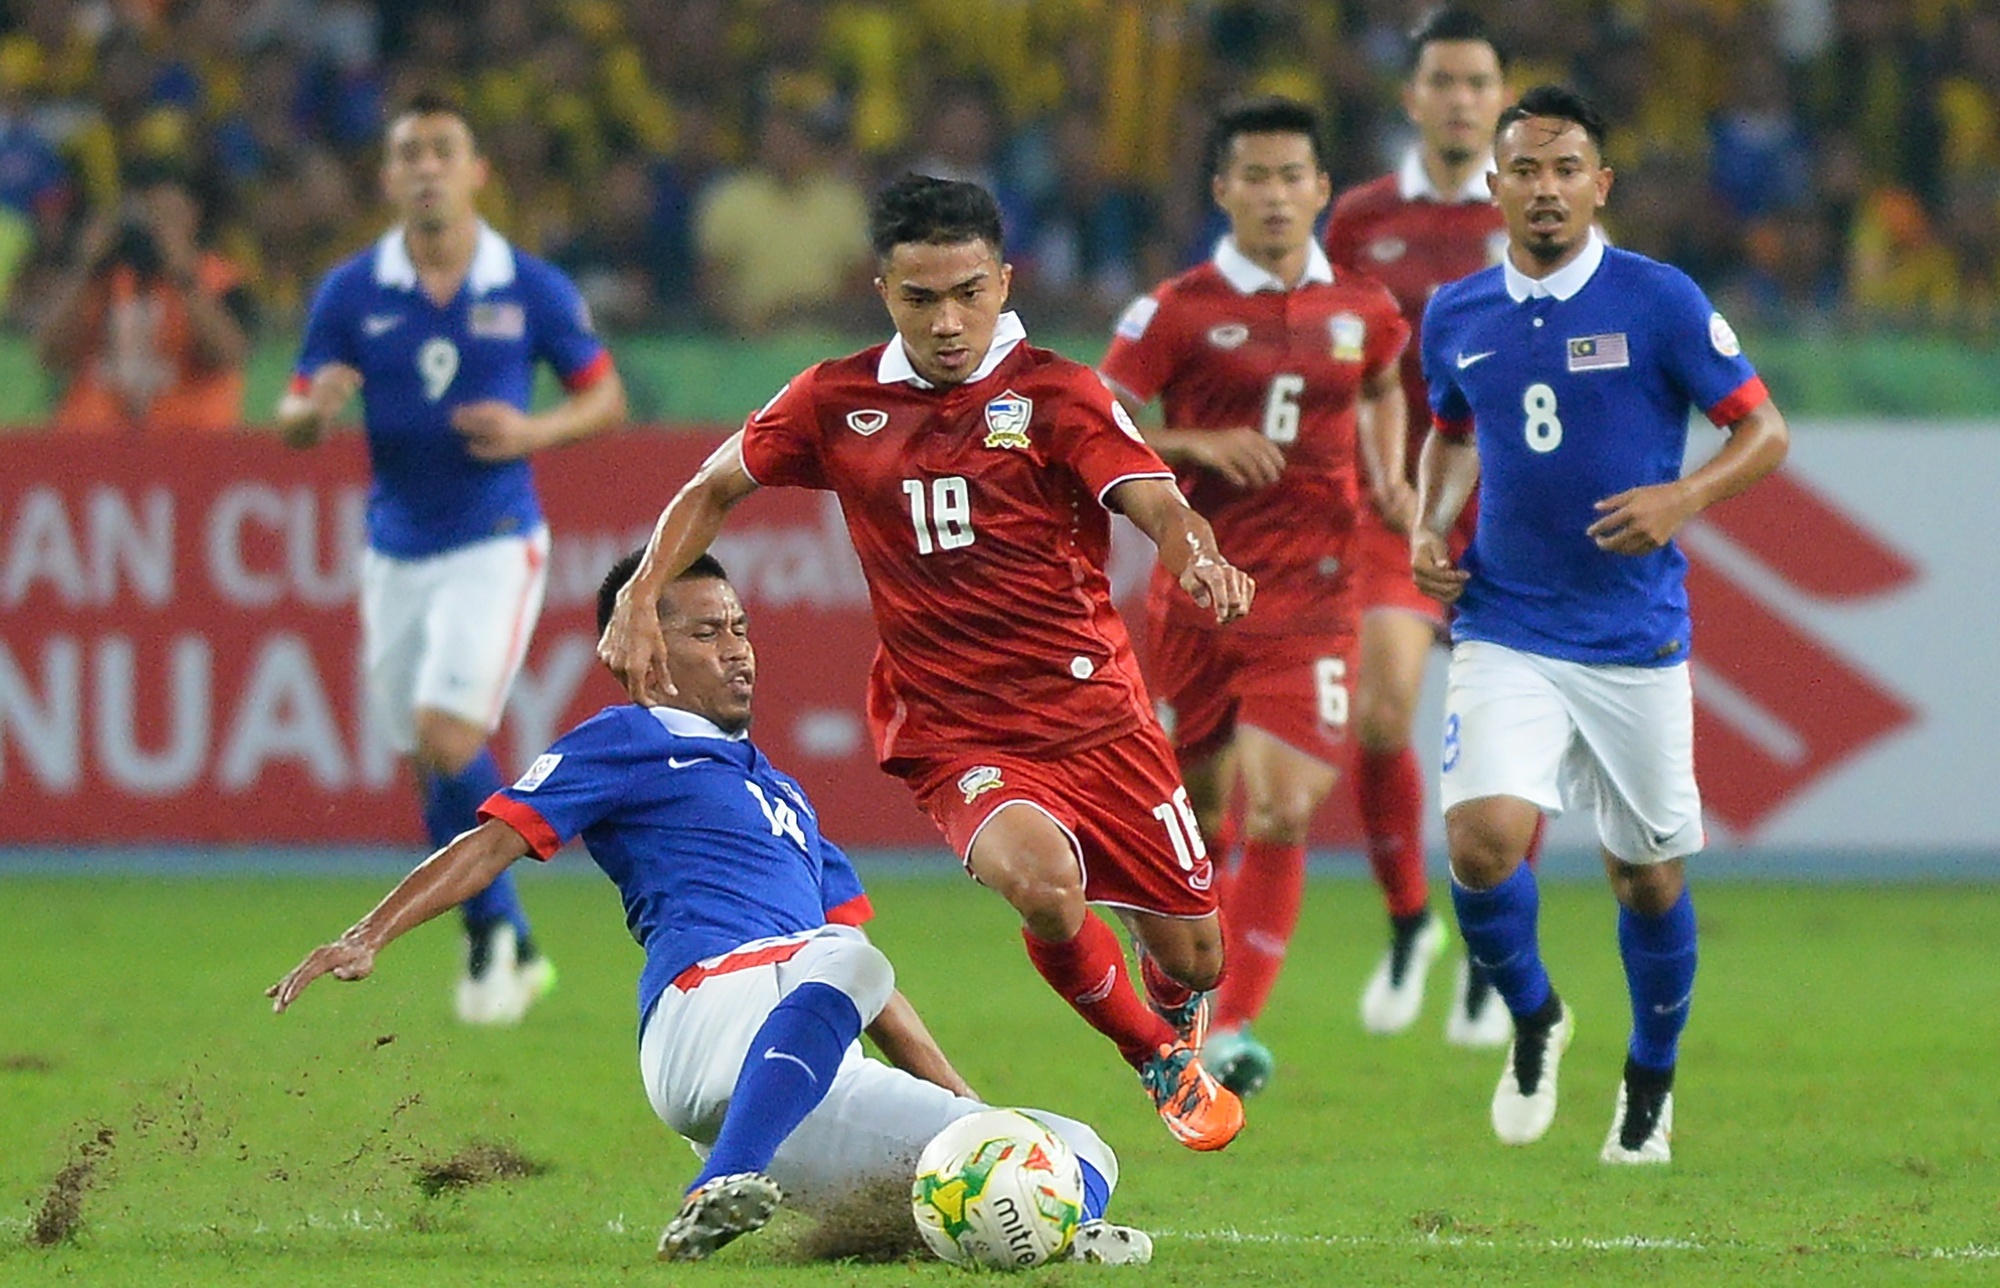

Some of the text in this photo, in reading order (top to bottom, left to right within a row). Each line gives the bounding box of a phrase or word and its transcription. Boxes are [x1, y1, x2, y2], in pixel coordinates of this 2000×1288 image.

[418, 338, 460, 401] 9
[1264, 375, 1302, 443] 6
[1523, 383, 1563, 454] 8
[207, 482, 368, 607] CU
[903, 476, 976, 555] 18
[1316, 656, 1348, 726] 6
[1442, 712, 1461, 774] 8
[745, 780, 808, 852] 14
[993, 1197, 1037, 1267] mitre
